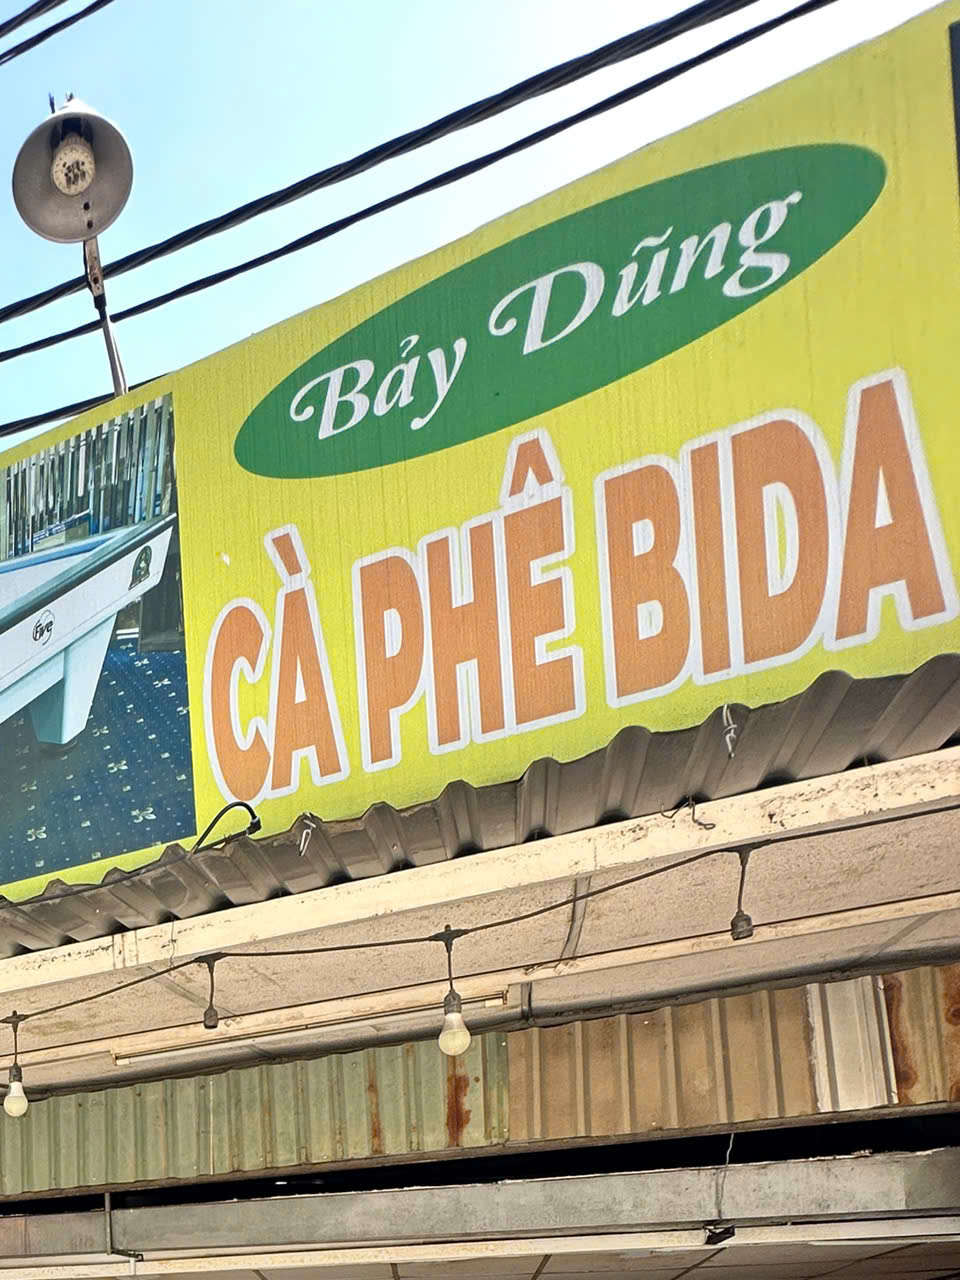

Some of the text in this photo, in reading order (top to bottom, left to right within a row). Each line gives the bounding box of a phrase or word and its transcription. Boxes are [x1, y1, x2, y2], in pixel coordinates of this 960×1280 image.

[290, 190, 803, 440] Bảy Dũng
[203, 366, 952, 802] CÀ PHÊ BIDA
